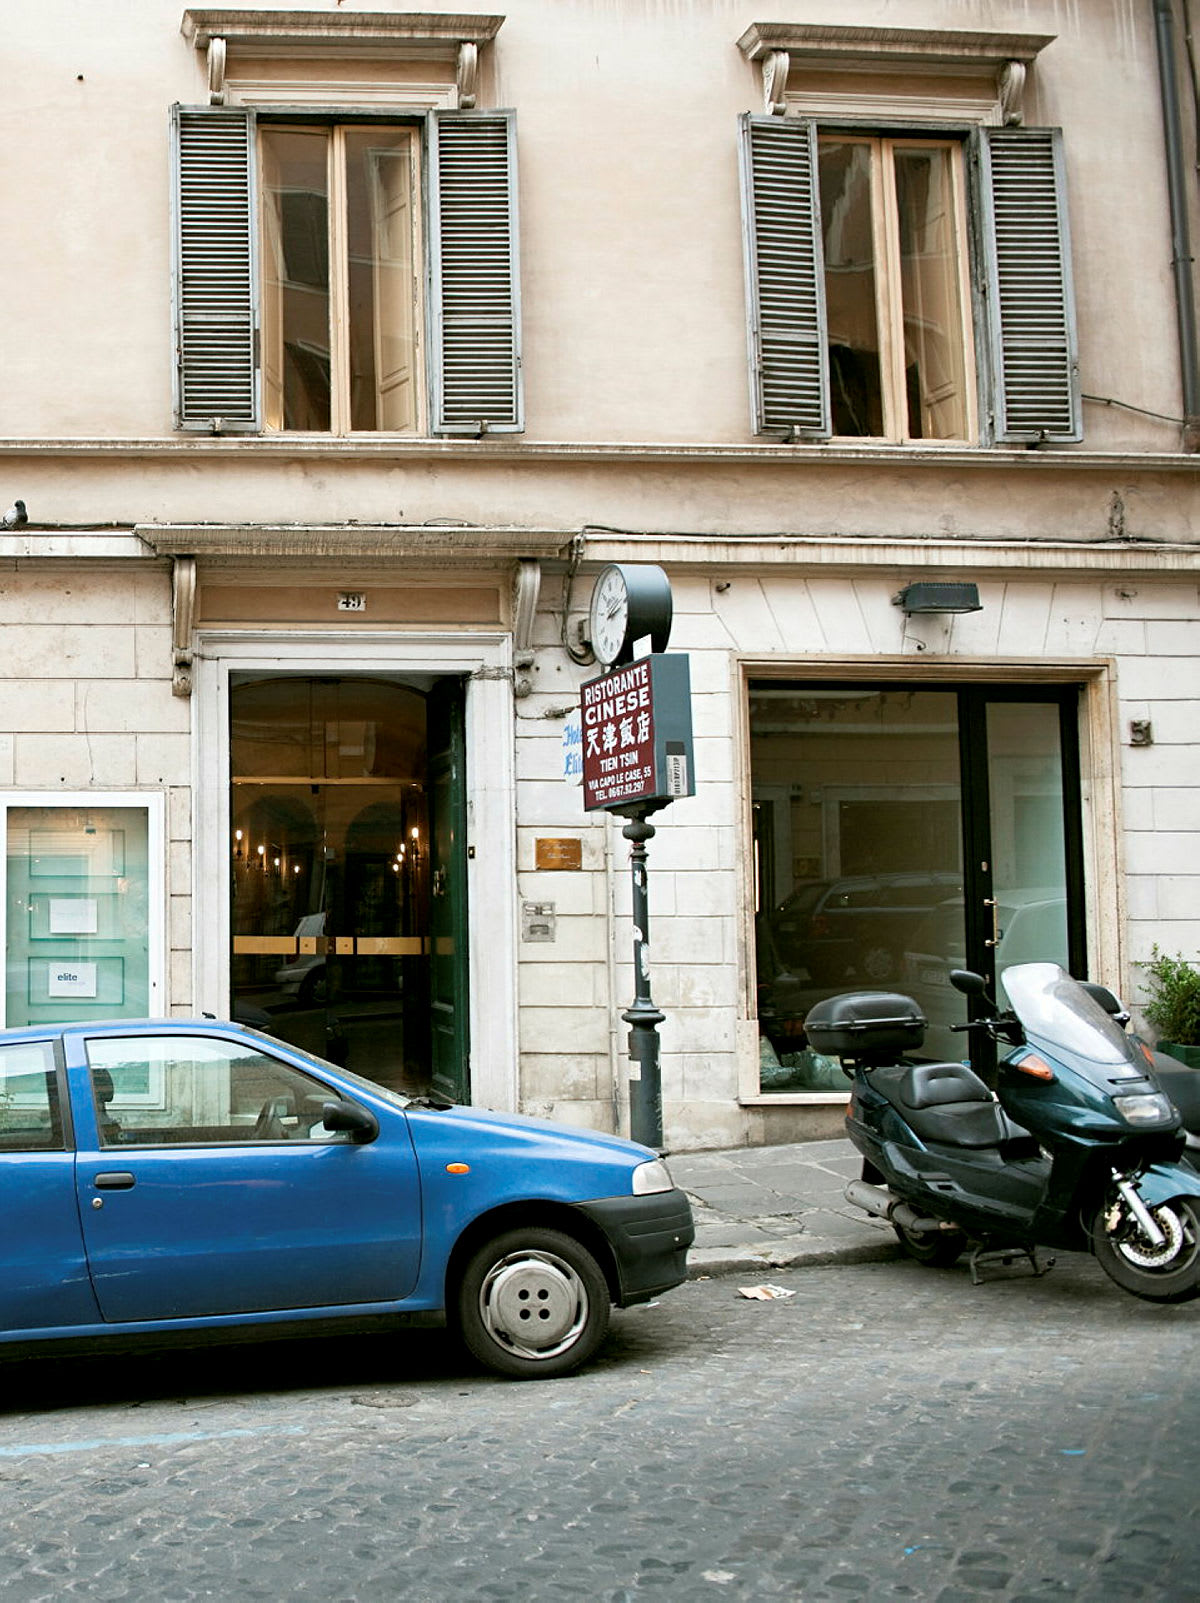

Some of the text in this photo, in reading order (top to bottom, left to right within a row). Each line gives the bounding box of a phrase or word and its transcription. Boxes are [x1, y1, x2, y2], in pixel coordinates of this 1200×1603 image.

[584, 664, 649, 706] RISTORANTE
[585, 686, 650, 725] CINESE
[586, 711, 650, 759] 天津飯店
[600, 750, 639, 773] TIEN TSIN
[588, 779, 599, 791] VIA
[616, 772, 624, 784] LE
[57, 972, 78, 981] elite
